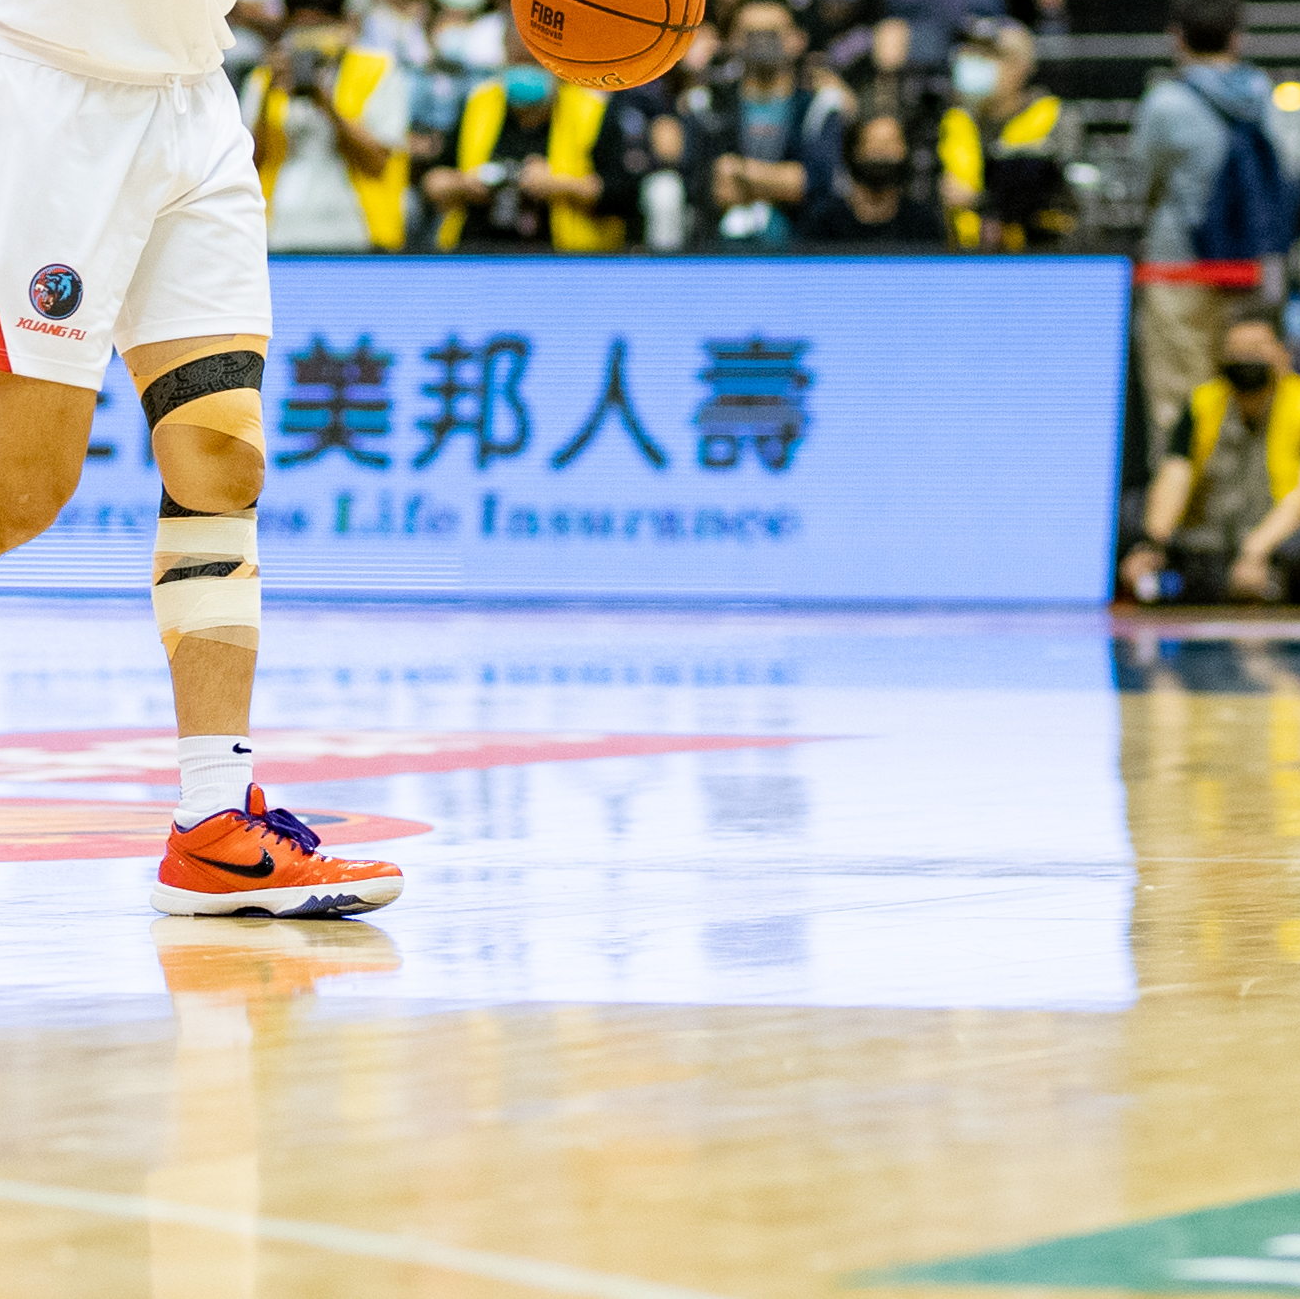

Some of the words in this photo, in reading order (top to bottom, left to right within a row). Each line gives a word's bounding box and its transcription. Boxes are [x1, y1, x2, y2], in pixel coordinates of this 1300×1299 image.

[531, 0, 565, 31] FIBA
[15, 317, 68, 338] KUANG
[67, 328, 88, 341] FU
[91, 334, 815, 472] 美邦人壽
